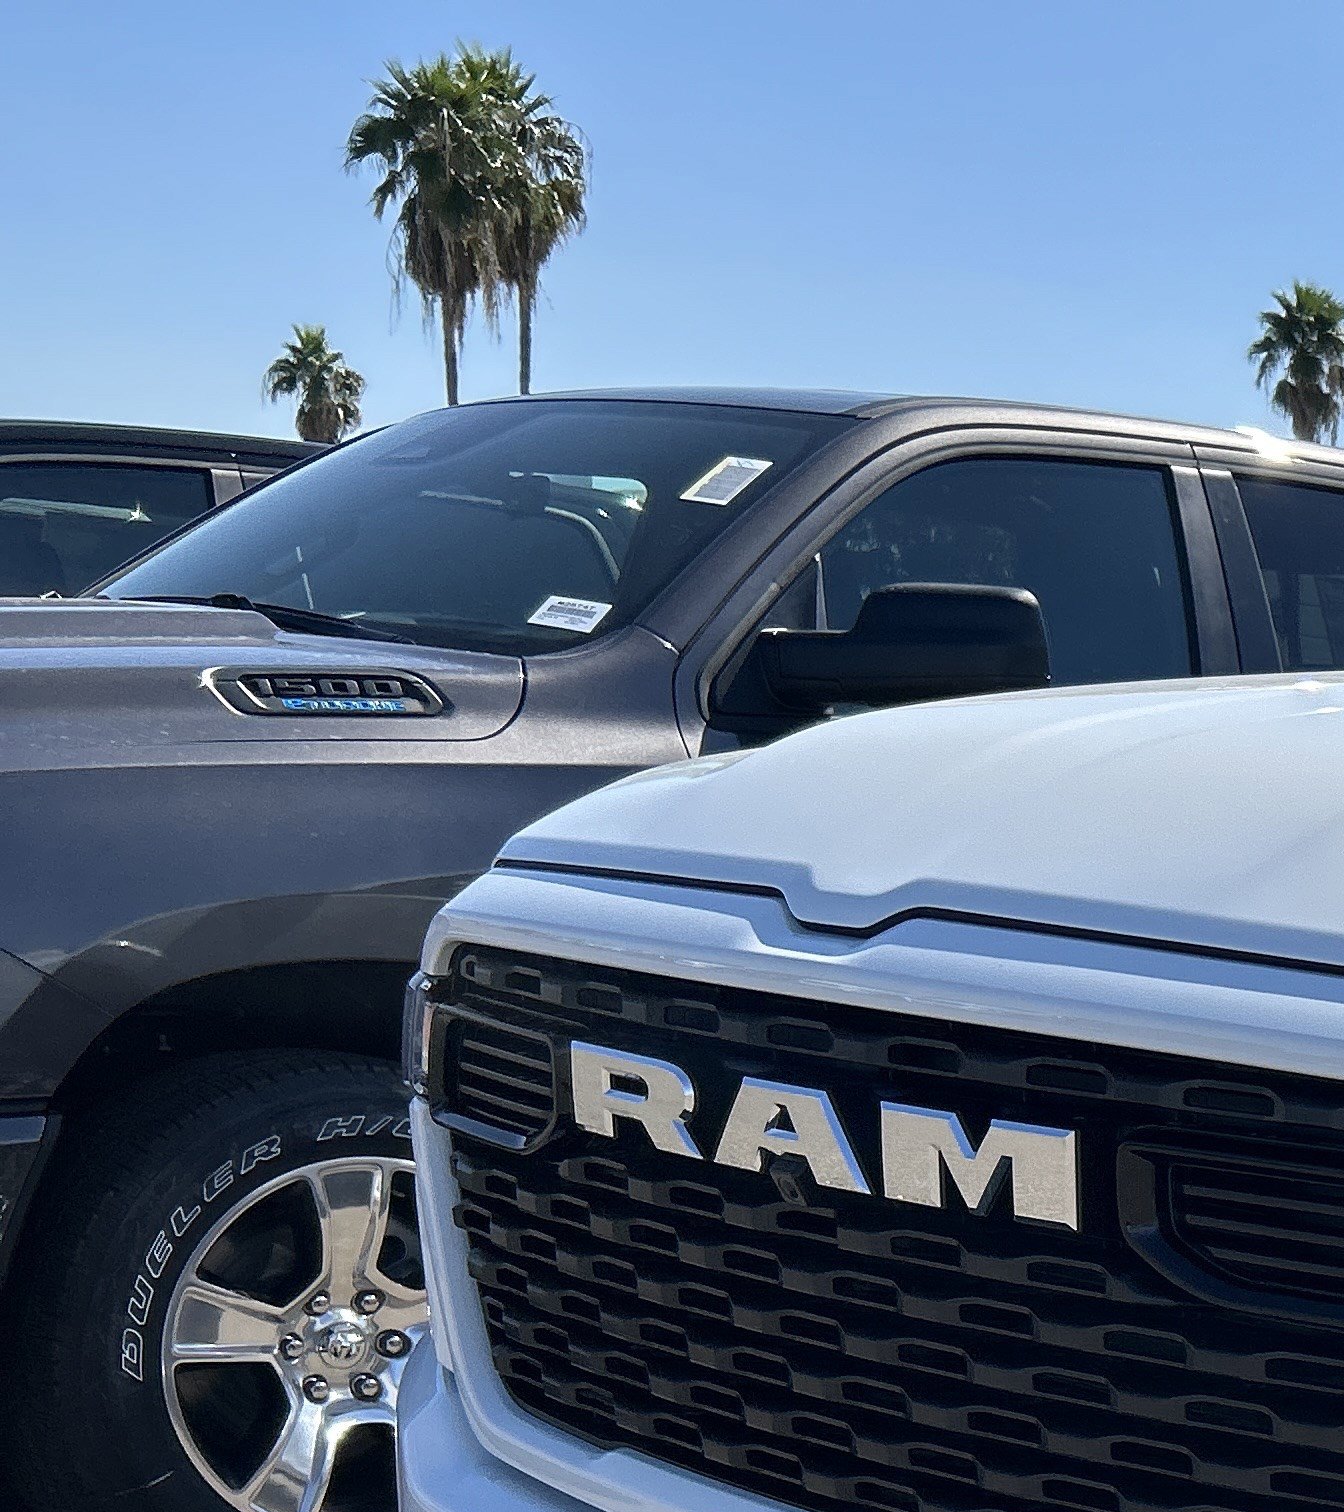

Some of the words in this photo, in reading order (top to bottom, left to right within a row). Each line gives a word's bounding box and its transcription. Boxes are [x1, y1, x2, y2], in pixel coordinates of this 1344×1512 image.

[252, 678, 403, 697] 1500
[571, 1040, 1079, 1231] RAM
[121, 1134, 281, 1381] DUELER
